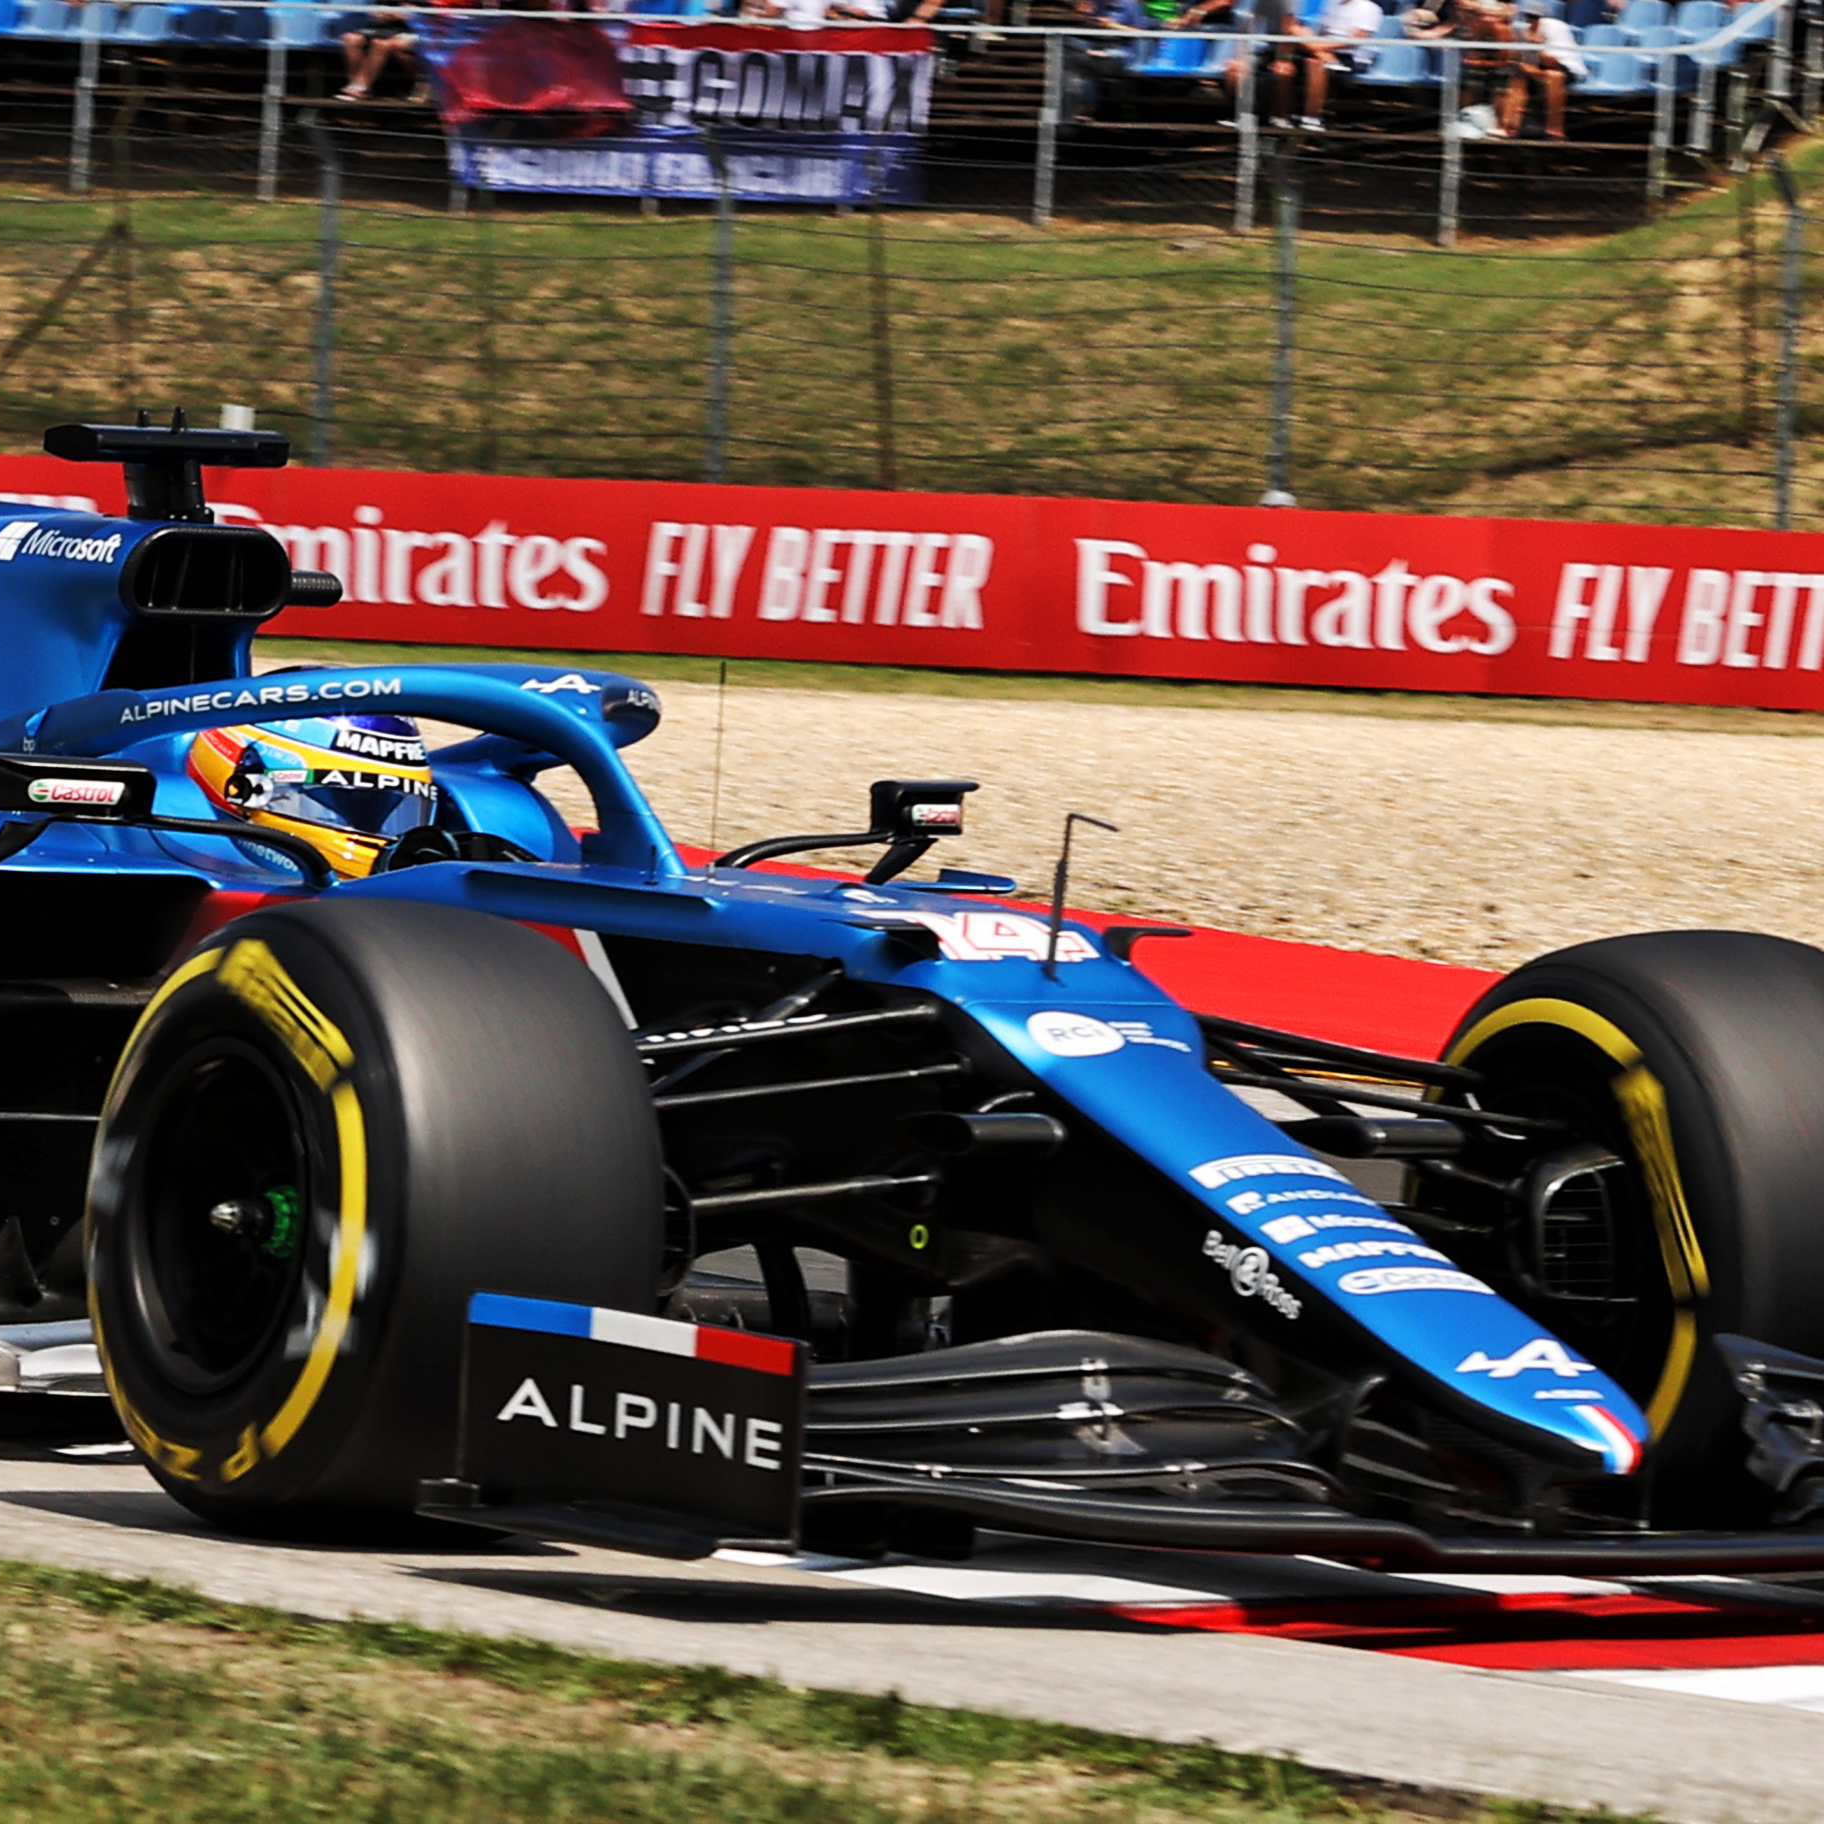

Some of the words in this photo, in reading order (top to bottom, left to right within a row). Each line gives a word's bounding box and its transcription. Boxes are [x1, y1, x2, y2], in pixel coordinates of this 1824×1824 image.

[21, 527, 123, 565] Microsoft
[204, 502, 610, 613] mirates
[641, 521, 758, 619] FLY
[757, 526, 994, 630] BETTER
[1075, 537, 1517, 656] Emirates
[1547, 562, 1673, 663] FLY
[119, 678, 403, 725] ALPINECARS.COM
[336, 730, 427, 762] MAPFRE
[51, 783, 117, 803] Castrol
[321, 769, 439, 801] ALPINE
[496, 1376, 784, 1472] ALPINE
